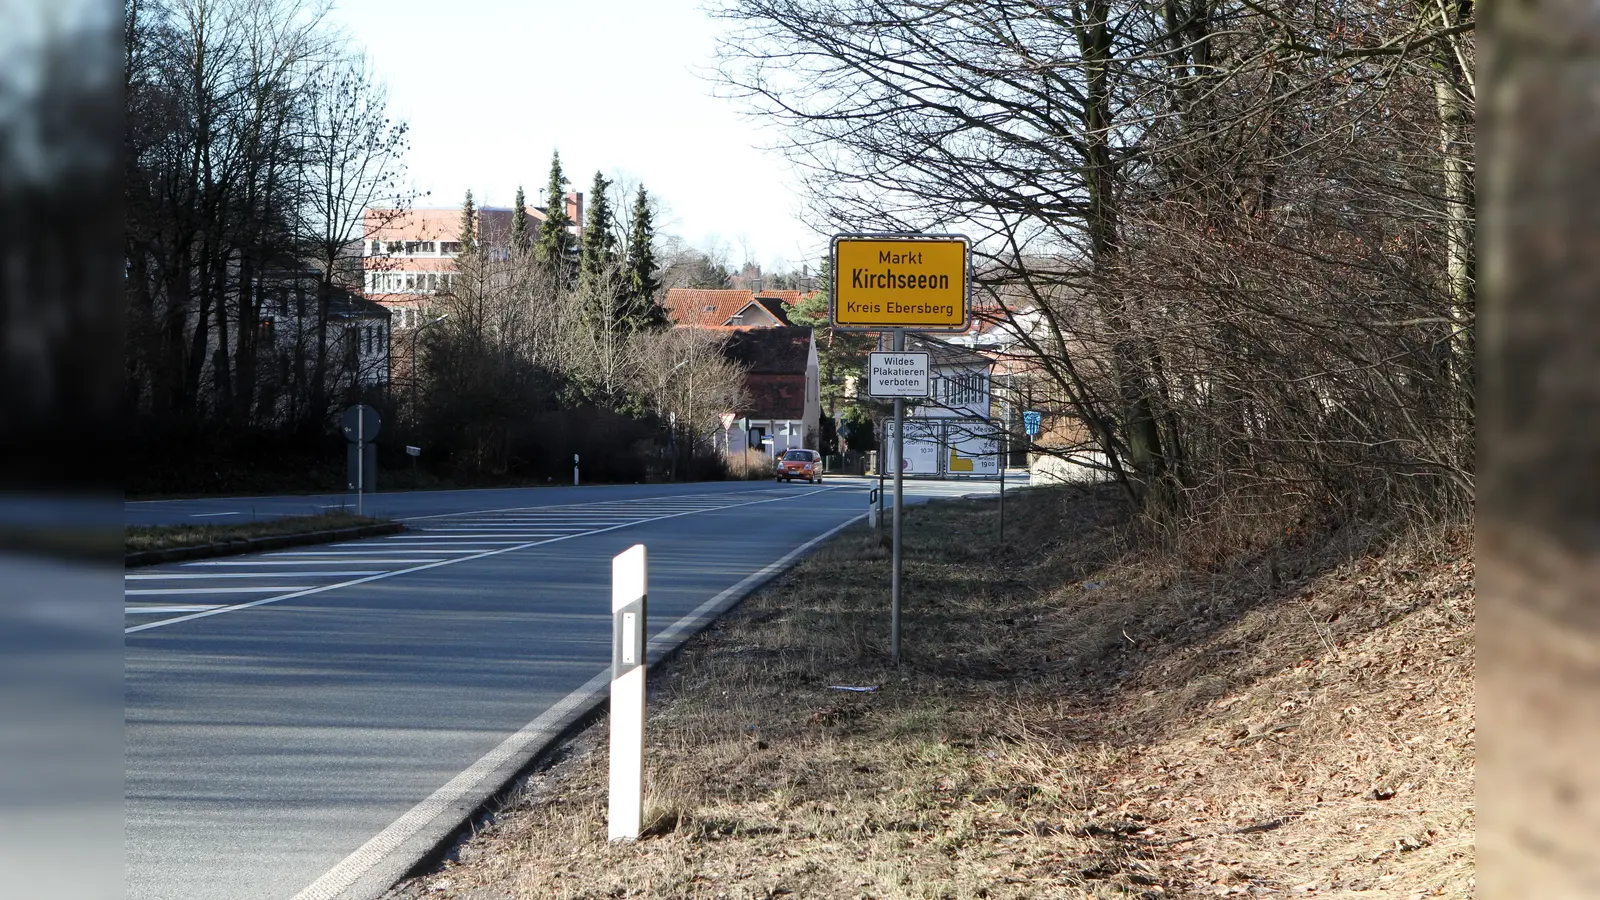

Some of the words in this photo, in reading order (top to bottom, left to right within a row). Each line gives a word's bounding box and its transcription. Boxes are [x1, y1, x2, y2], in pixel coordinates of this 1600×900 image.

[879, 251, 923, 264] Markt
[852, 268, 949, 289] Kirchseeon
[847, 302, 881, 313] Kreis
[886, 302, 953, 317] Ebersberg
[884, 357, 915, 366] Wildes
[873, 367, 925, 376] Plakatieren
[879, 378, 919, 386] verboten
